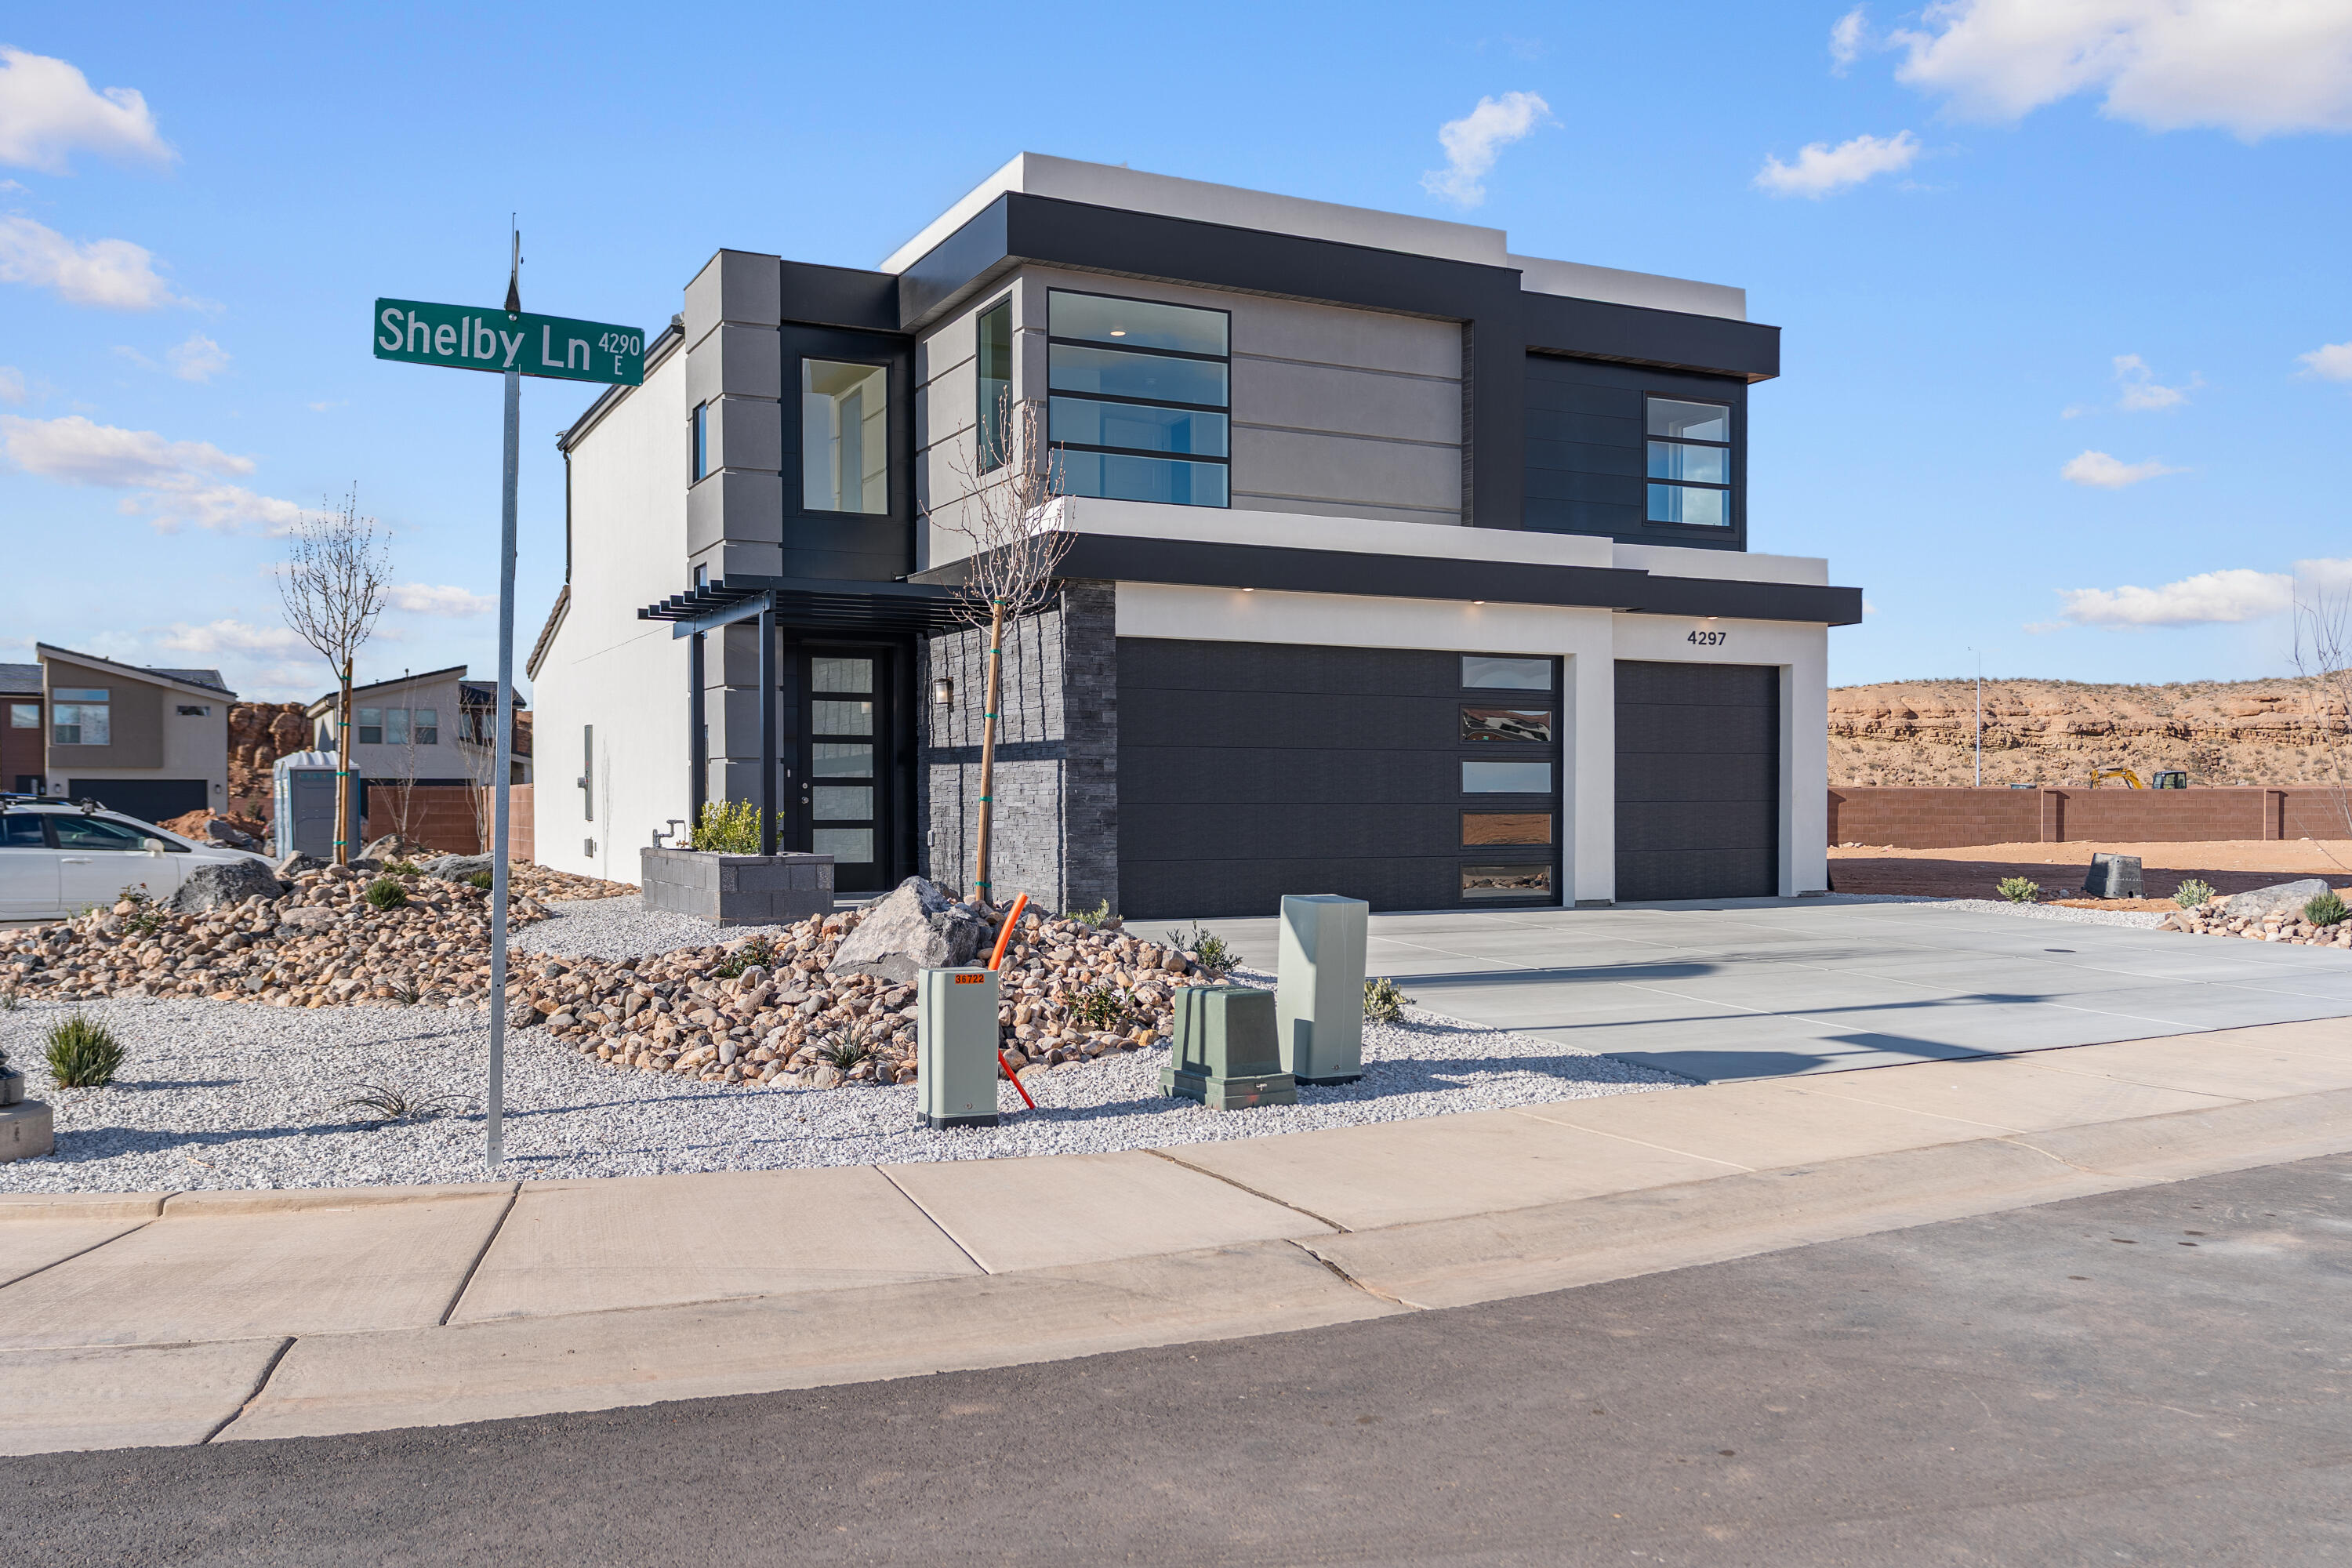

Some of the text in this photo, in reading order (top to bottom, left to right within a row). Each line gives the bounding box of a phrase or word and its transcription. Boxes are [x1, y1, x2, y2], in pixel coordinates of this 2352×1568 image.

[378, 308, 590, 371] Shelby Ln
[598, 332, 641, 356] 4290
[614, 355, 623, 376] E
[1687, 630, 1726, 645] 4297
[956, 974, 984, 984] 36722
